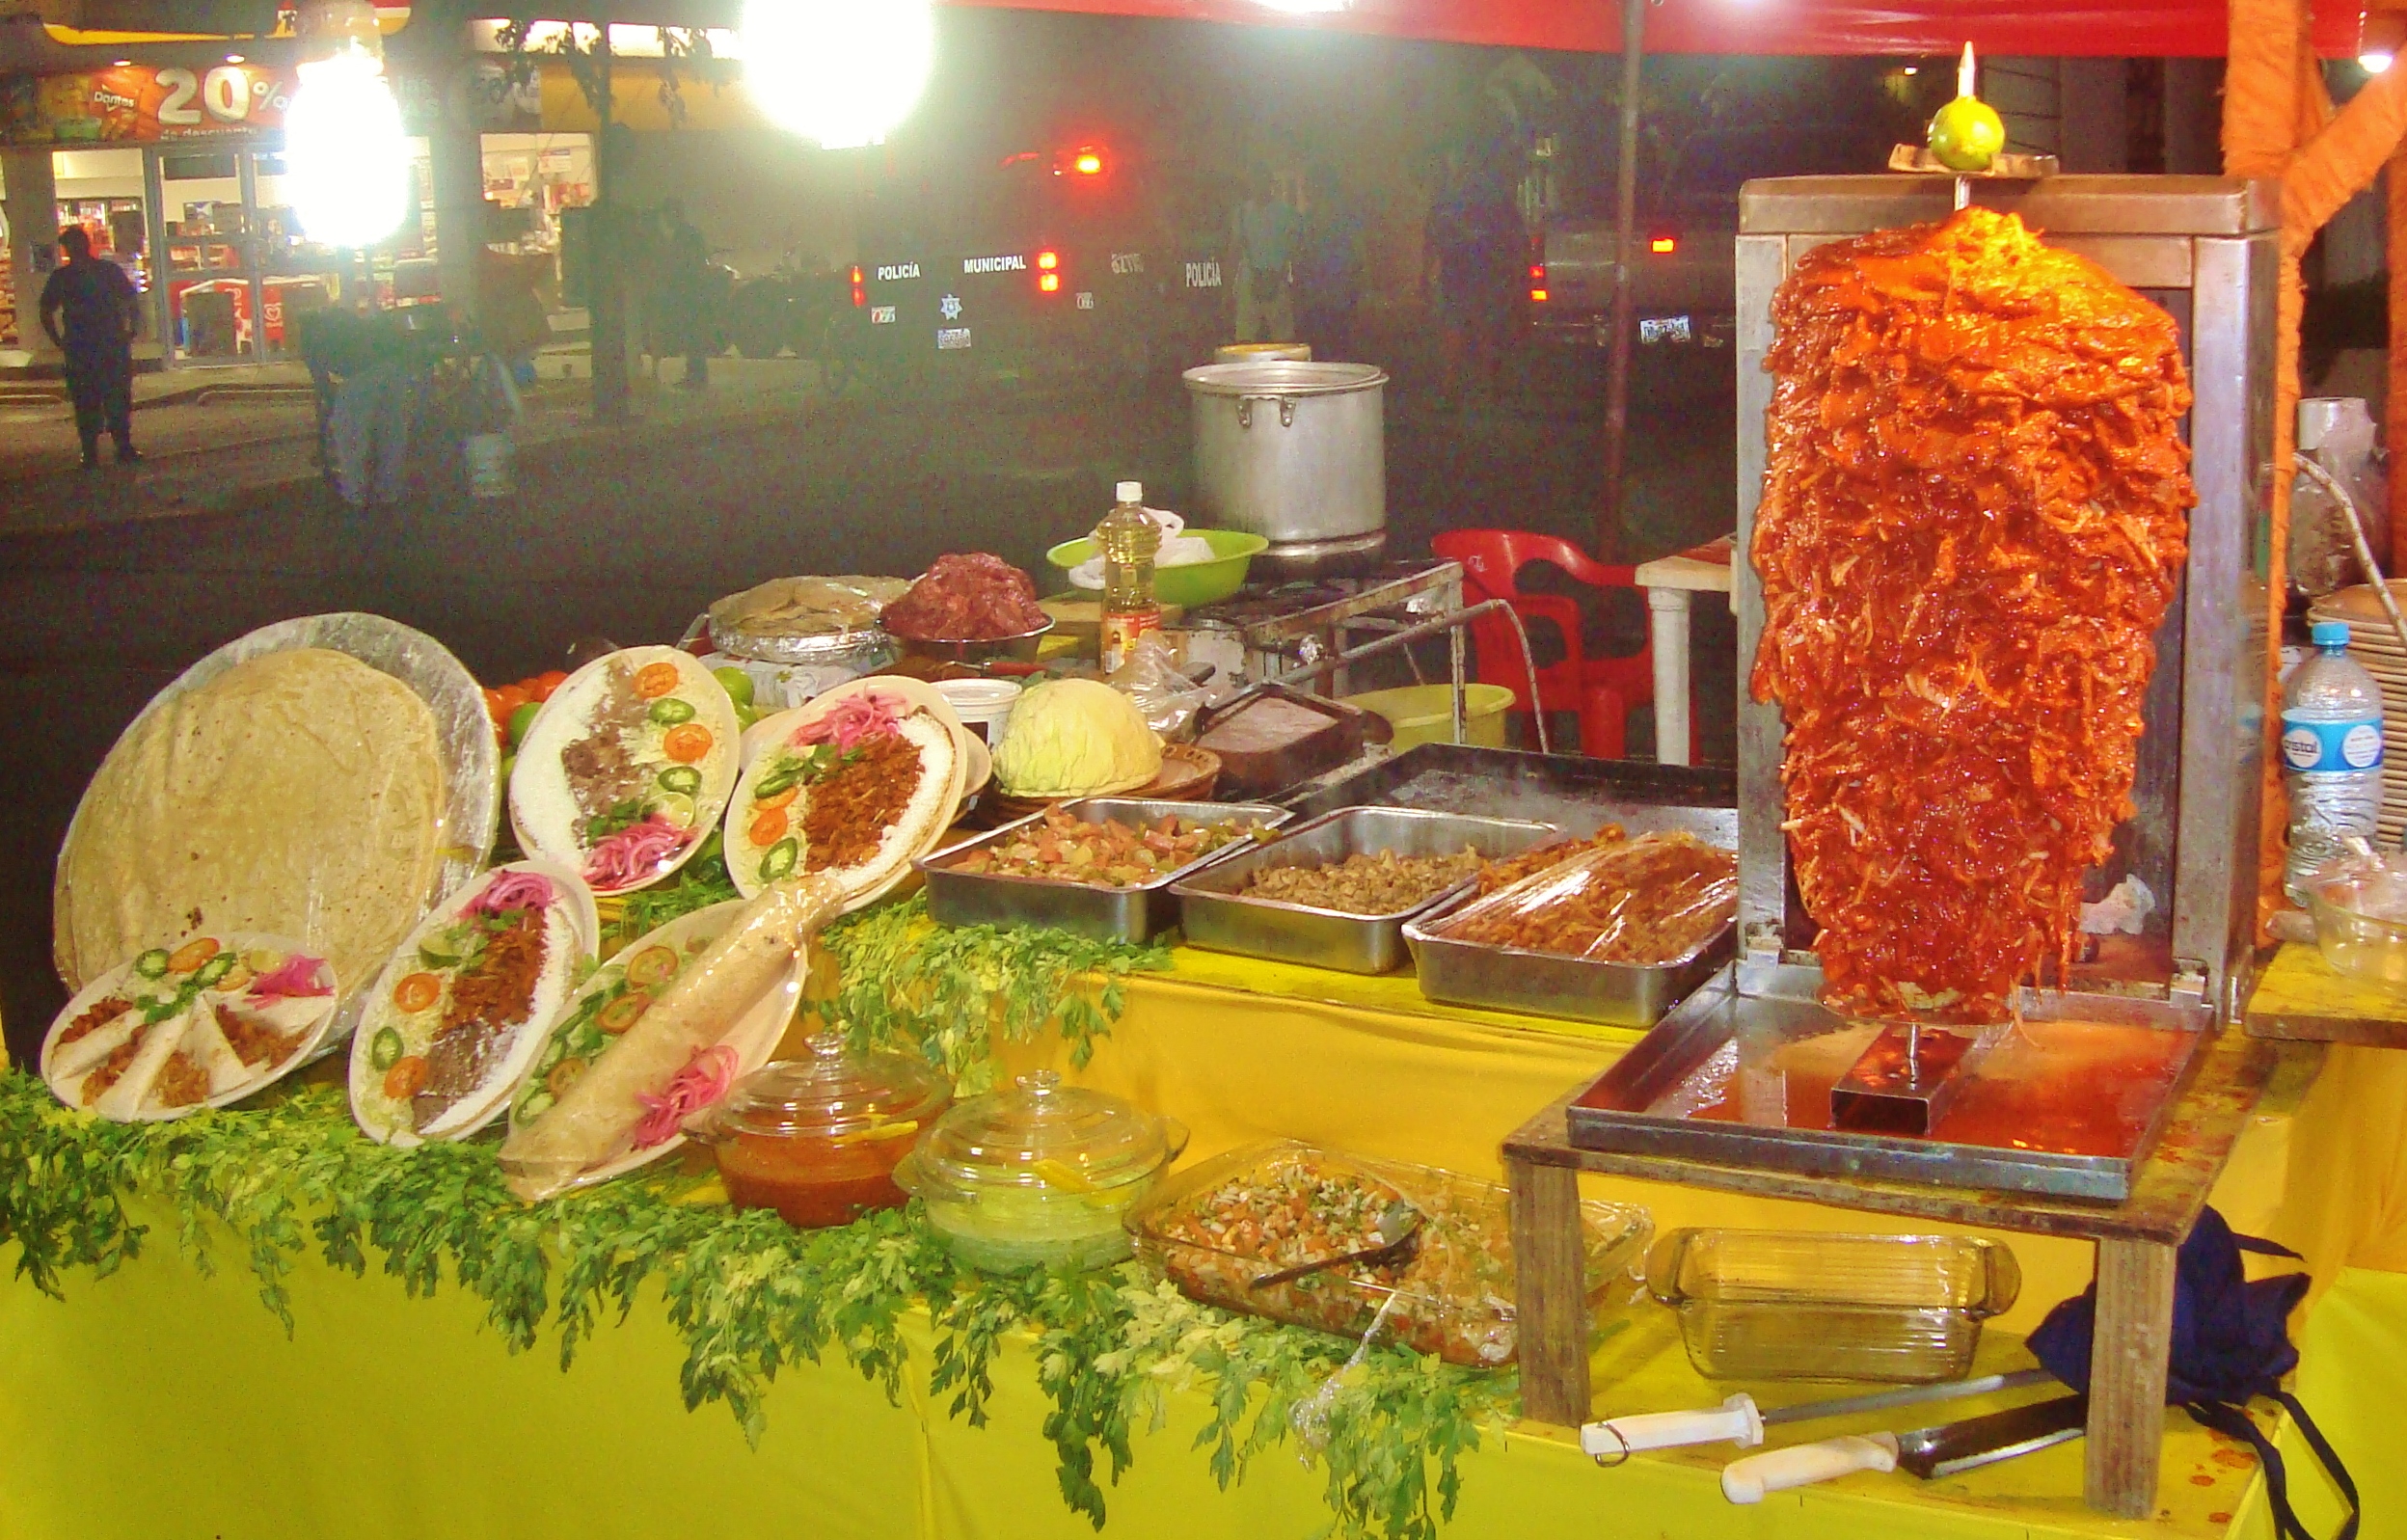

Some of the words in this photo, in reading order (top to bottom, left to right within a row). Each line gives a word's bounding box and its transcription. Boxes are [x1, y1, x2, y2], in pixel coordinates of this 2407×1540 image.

[878, 261, 921, 281] POLICÍA
[964, 256, 1026, 274] MUNICIPAL
[1185, 257, 1222, 287] POLICÍA
